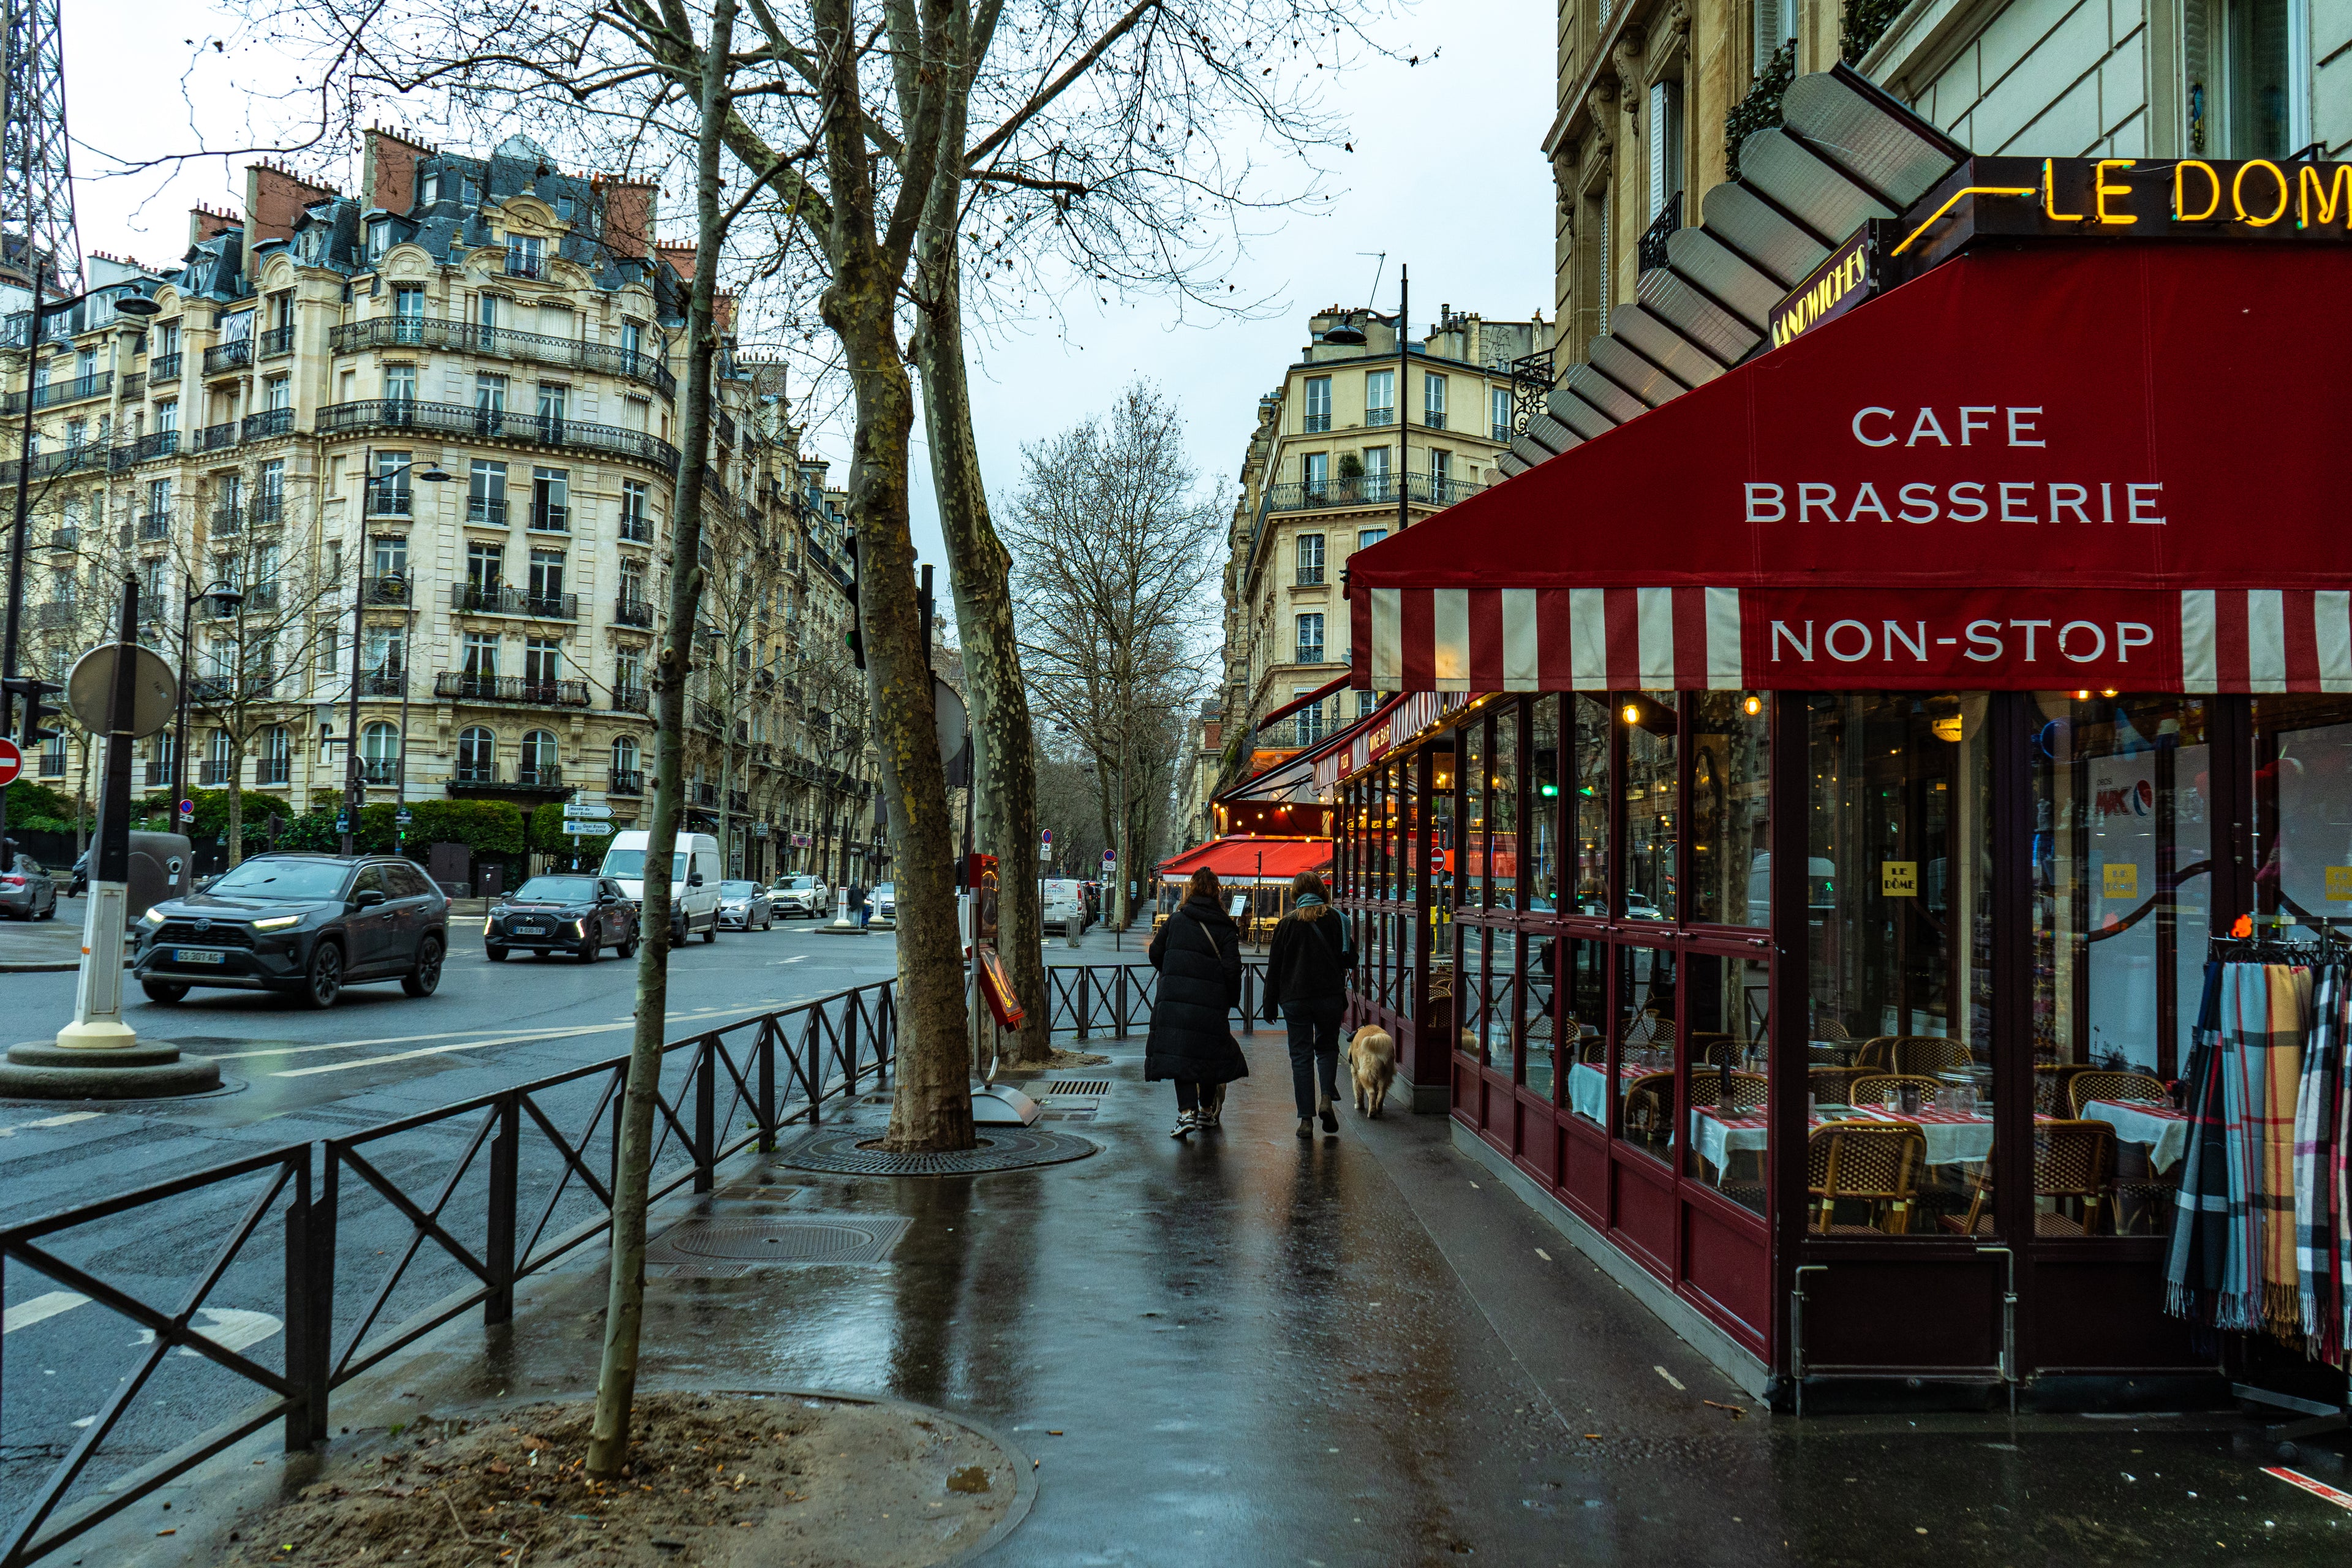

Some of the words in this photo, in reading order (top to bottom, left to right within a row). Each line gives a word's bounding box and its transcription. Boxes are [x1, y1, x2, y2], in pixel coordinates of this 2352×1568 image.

[2041, 158, 2138, 225] LE
[2171, 159, 2352, 230] DOM
[1772, 244, 1866, 349] SANDWICHES
[1851, 405, 2046, 449] CAFE
[1743, 481, 2167, 526] BRASSERIE
[1770, 619, 2155, 663] NON-STOP
[1369, 731, 1380, 753] WINE
[1380, 724, 1390, 746] BAR
[1884, 877, 1915, 889] DÔME
[178, 951, 218, 962] GS-307-AG
